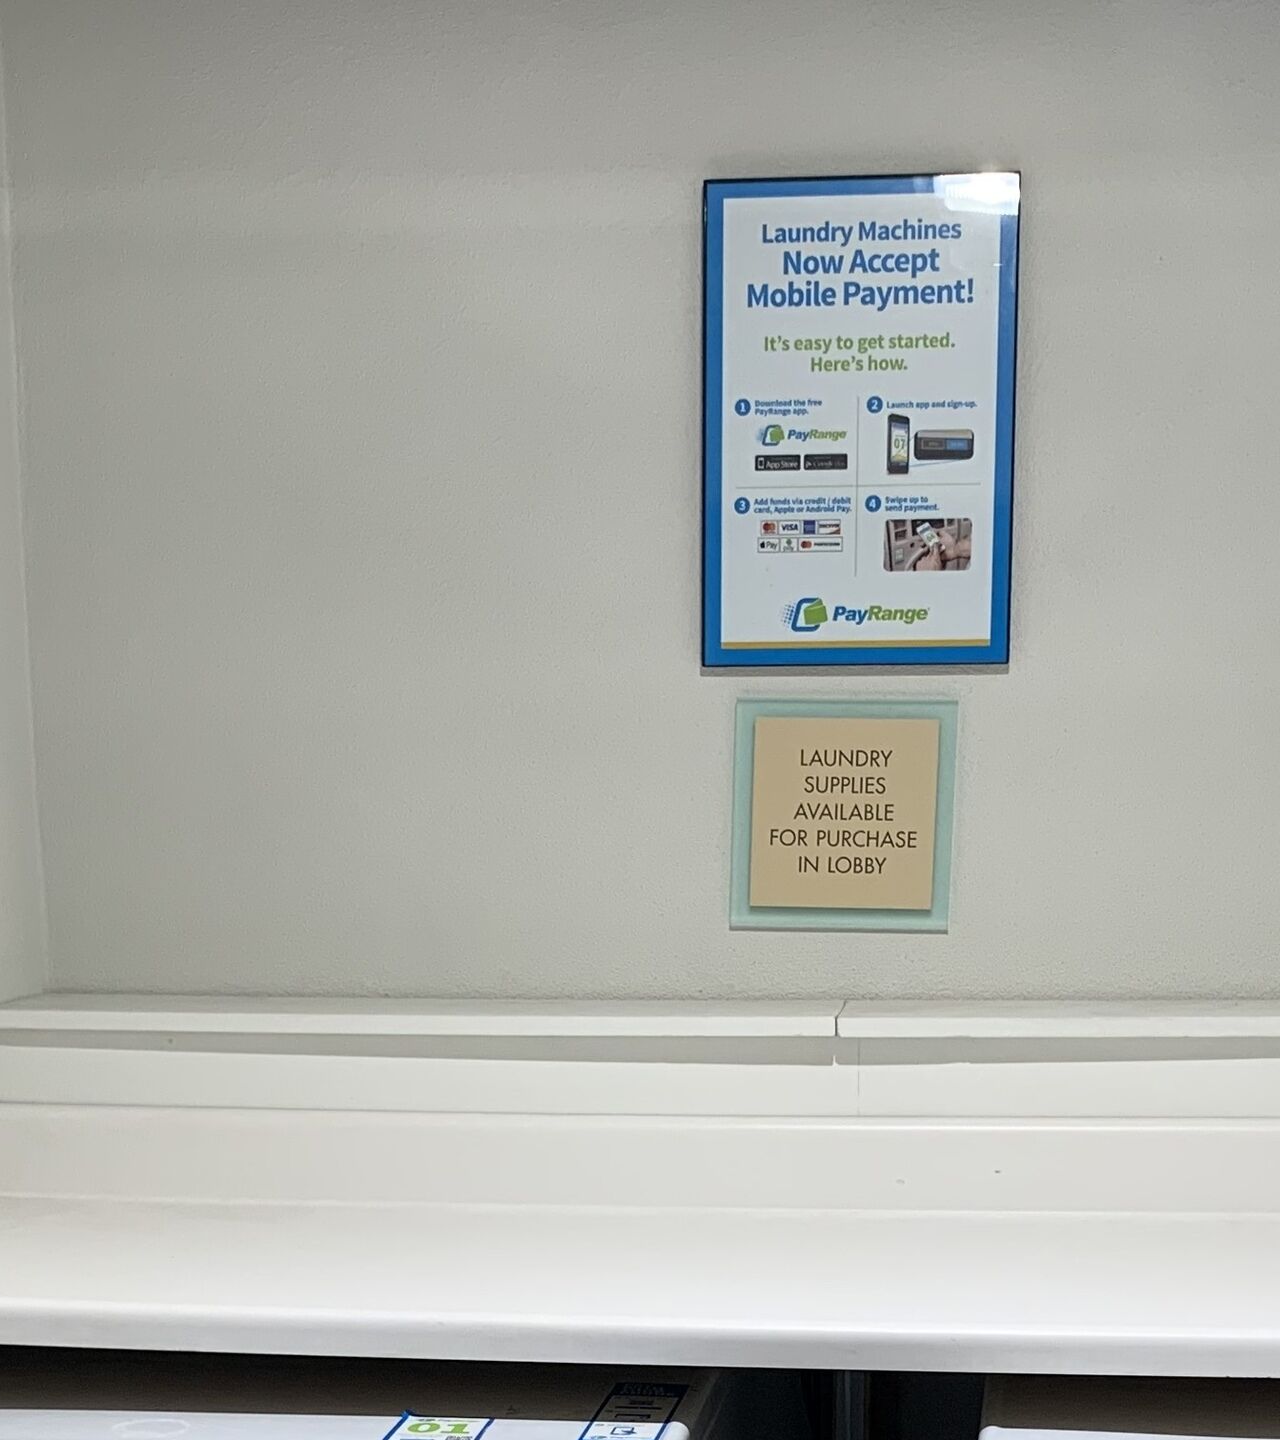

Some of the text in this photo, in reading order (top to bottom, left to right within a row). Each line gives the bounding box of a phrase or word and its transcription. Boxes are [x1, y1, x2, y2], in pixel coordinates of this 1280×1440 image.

[762, 219, 962, 246] Laundry Machines
[783, 248, 940, 278] Now Accept
[747, 278, 975, 311] Mobile Payment!
[794, 338, 832, 354] easy
[836, 335, 854, 350] to
[857, 335, 884, 354] get
[888, 332, 956, 349] started.
[868, 355, 908, 371] how.
[754, 399, 792, 407] Download
[793, 399, 806, 407] the
[886, 400, 978, 410] Launch app and sign-up.
[754, 407, 809, 417] PayRange app.
[787, 428, 848, 442] PayRange
[781, 460, 799, 469] Store
[754, 497, 769, 506] Add
[769, 497, 791, 505] funds
[792, 497, 804, 505] via
[804, 496, 826, 505] credit
[832, 496, 852, 505] debit
[885, 496, 929, 505] Swipe up to
[753, 505, 773, 515] card,
[774, 505, 795, 514] Apple
[805, 504, 835, 513] Android
[836, 504, 853, 514] Pay.
[885, 503, 940, 513] send payment.
[781, 523, 799, 531] VISA
[766, 541, 778, 550] Pay
[832, 604, 929, 626] PayRange
[800, 749, 893, 767] LAUNDRY
[803, 776, 886, 794] SUPPLIES
[793, 803, 894, 821] AVAILABLE
[770, 829, 917, 848] FOR PURCHASE
[798, 856, 887, 874] IN LOBBY
[408, 1422, 469, 1434] 01
